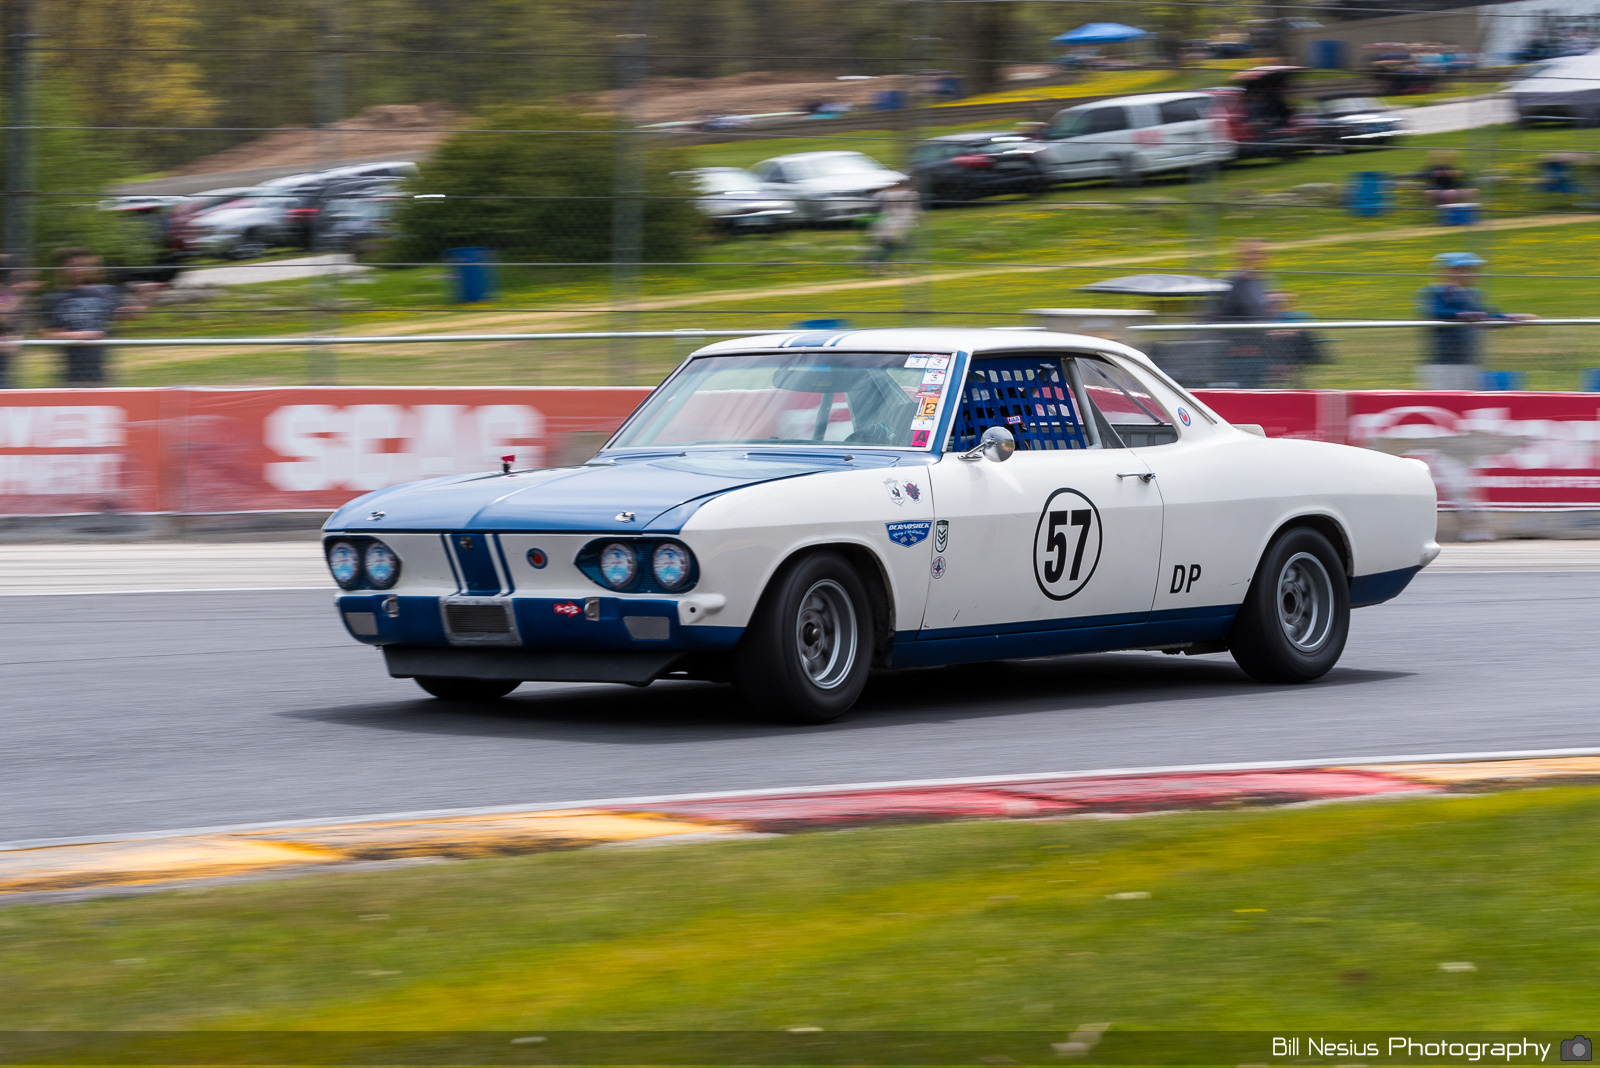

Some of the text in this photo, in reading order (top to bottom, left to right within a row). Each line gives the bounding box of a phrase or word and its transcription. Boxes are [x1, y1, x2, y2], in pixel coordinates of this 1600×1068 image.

[914, 431, 926, 443] A
[1044, 509, 1092, 583] 57
[1169, 564, 1202, 594] DP
